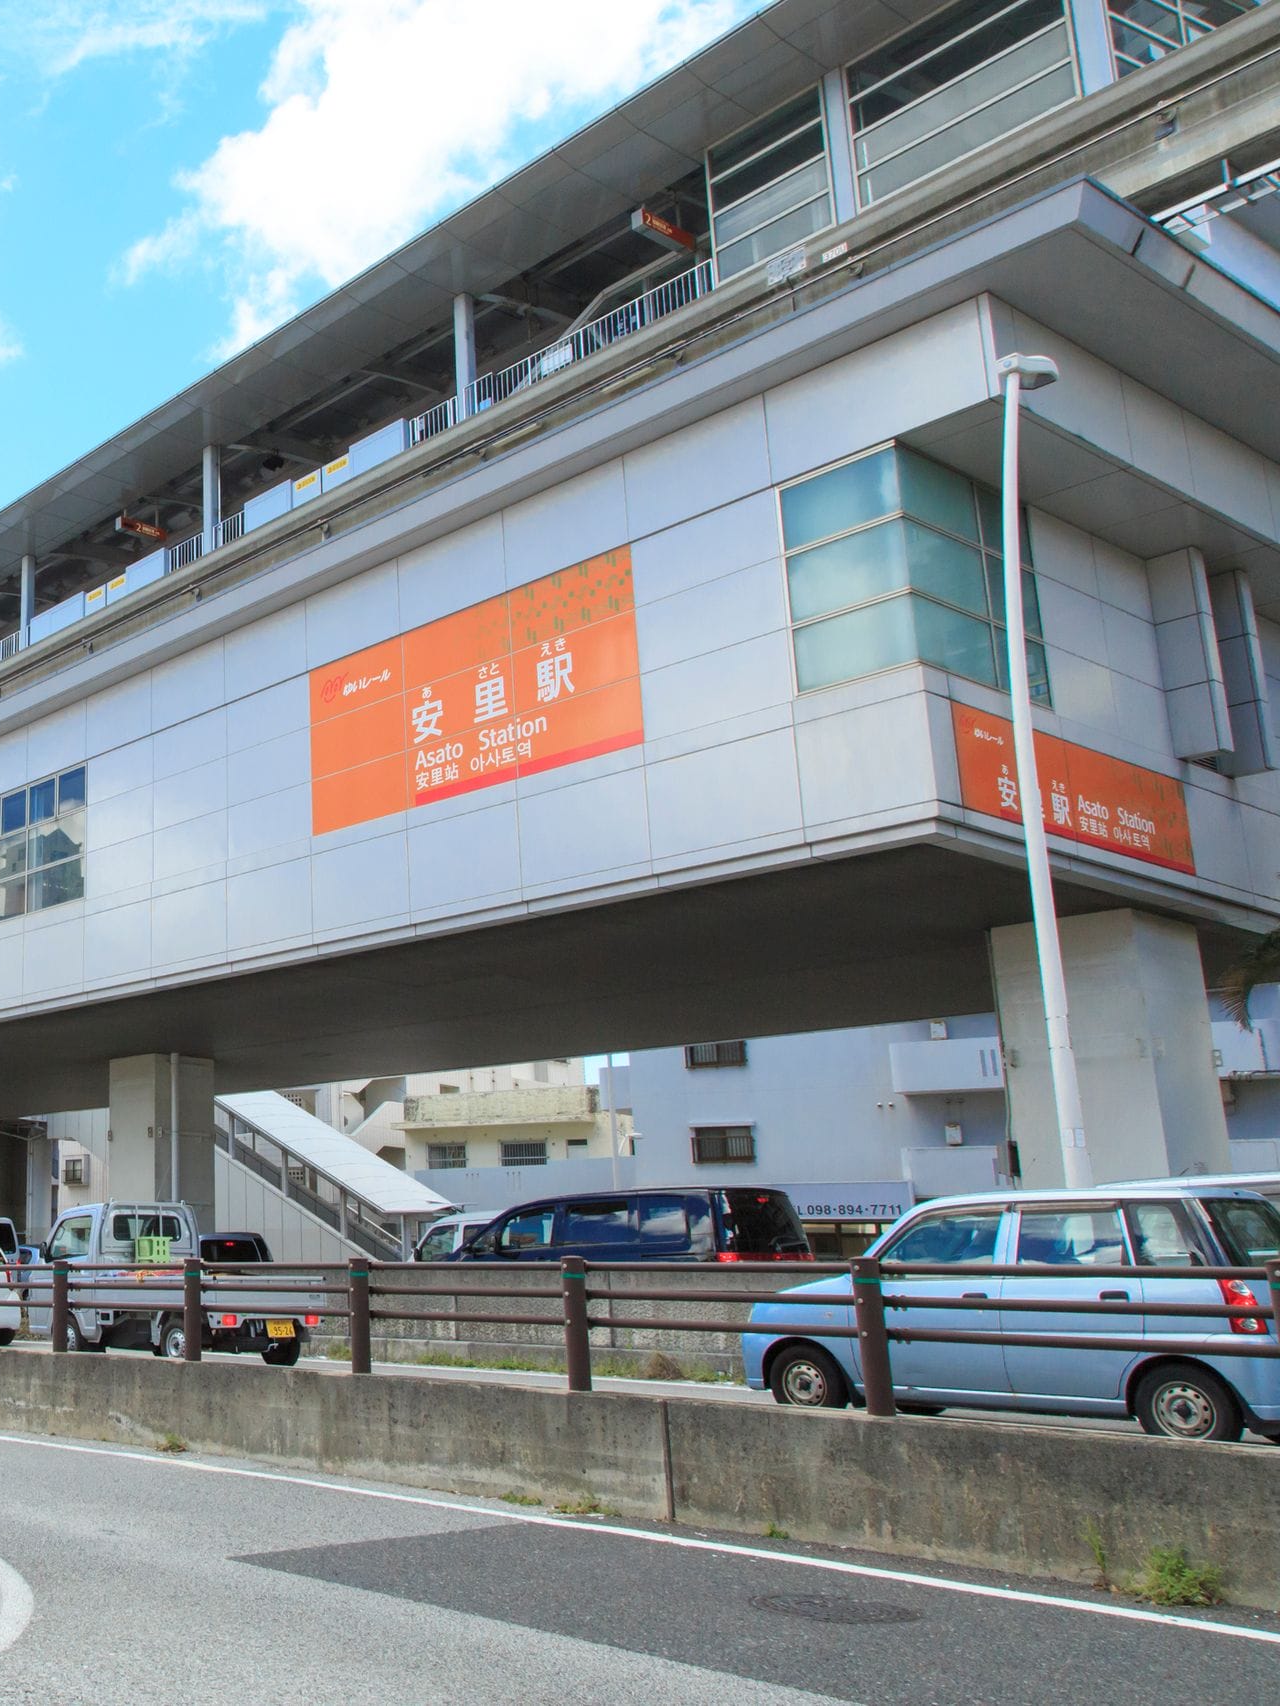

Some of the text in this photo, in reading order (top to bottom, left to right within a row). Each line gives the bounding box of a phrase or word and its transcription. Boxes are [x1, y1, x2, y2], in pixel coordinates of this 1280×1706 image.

[343, 668, 391, 697] ゆいレール
[421, 638, 567, 700] あ さと えき
[415, 714, 548, 771] Asato Station
[415, 739, 532, 791] 安里站 아사토역
[997, 776, 1072, 827] 安駅
[1077, 794, 1156, 835] Asato Station
